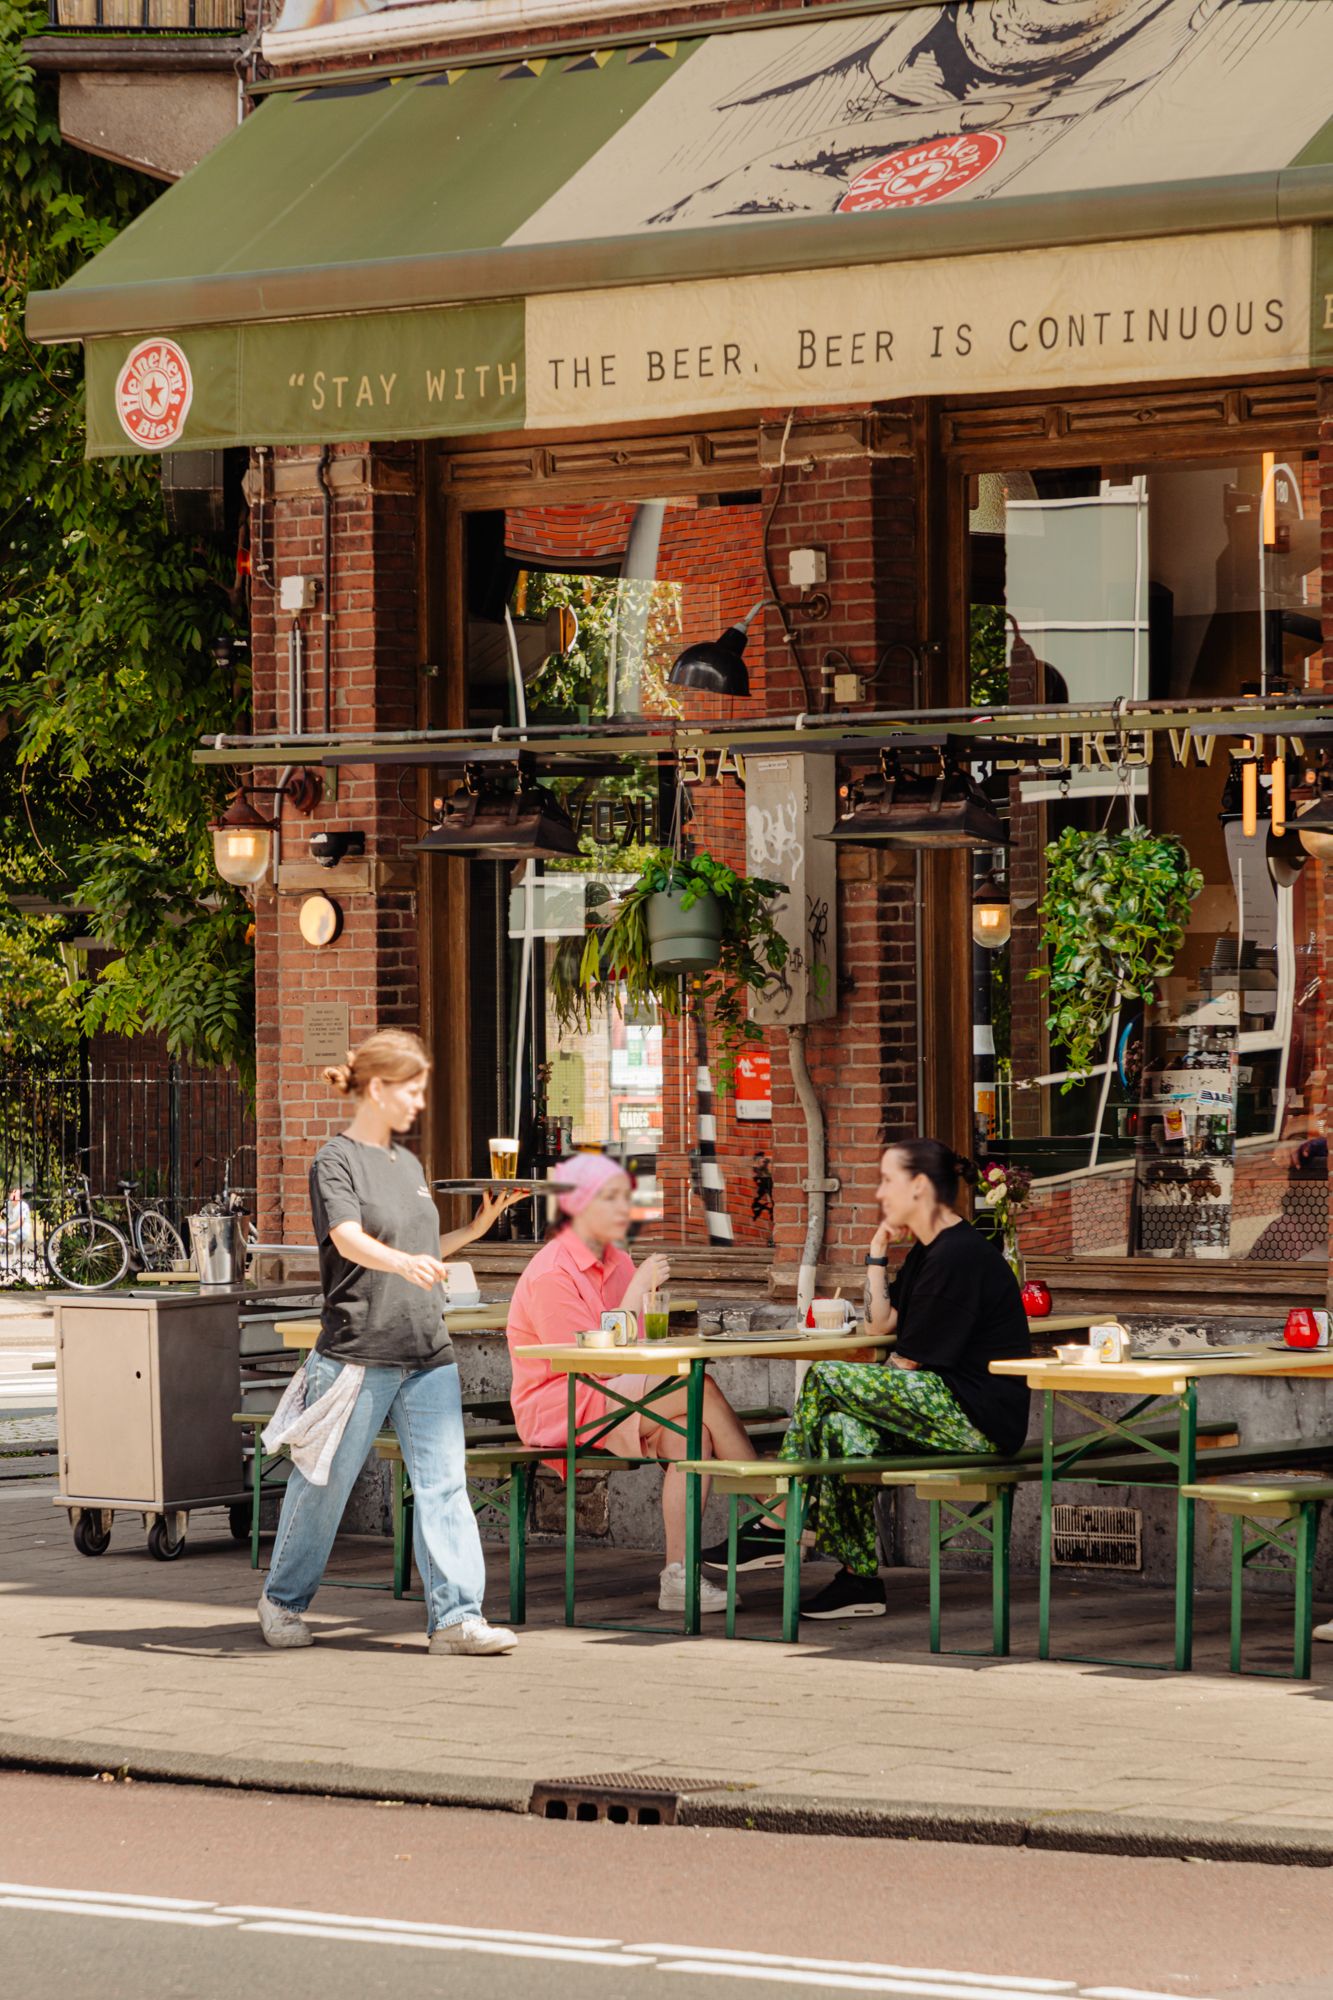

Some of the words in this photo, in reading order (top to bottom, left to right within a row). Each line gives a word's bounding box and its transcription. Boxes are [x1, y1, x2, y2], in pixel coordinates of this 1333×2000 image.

[426, 362, 517, 402] WITH
[548, 354, 616, 389] THE
[797, 329, 894, 370] BEER
[930, 323, 973, 358] IS
[1008, 299, 1284, 352] CONTINUOUS
[136, 418, 175, 439] Bier
